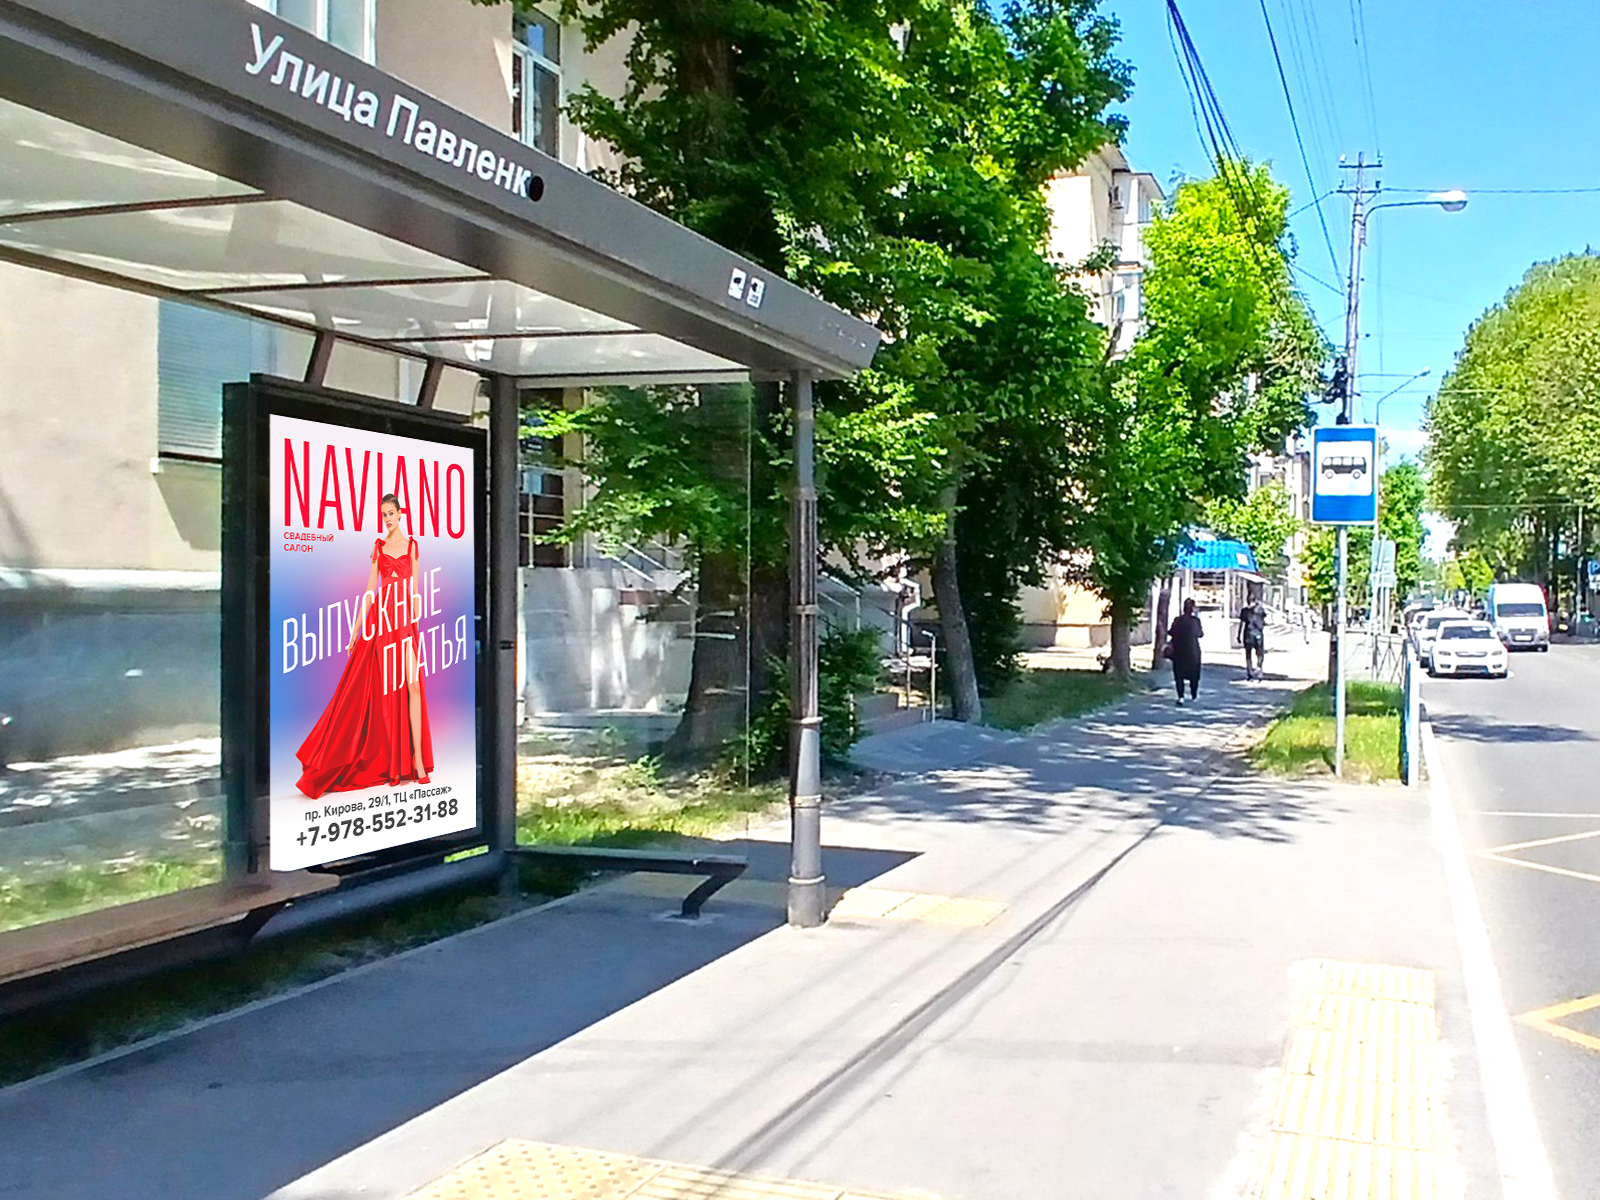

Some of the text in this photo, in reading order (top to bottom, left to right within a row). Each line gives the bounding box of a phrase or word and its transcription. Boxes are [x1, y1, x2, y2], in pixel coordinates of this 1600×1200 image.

[245, 22, 545, 202] Улица Павленк
[284, 437, 466, 540] NAVIANO
[283, 531, 335, 543] СВАДЕБНЫЙ
[283, 543, 314, 553] САЛОН
[282, 566, 442, 675] ВЫПУСКНЫЕ
[383, 614, 467, 696] ПЛАТЬЯ
[296, 798, 459, 847] +7-978-552-31-88
[304, 785, 453, 822] пр. Кирова, 29/1, ТЦ «Пассаж»
